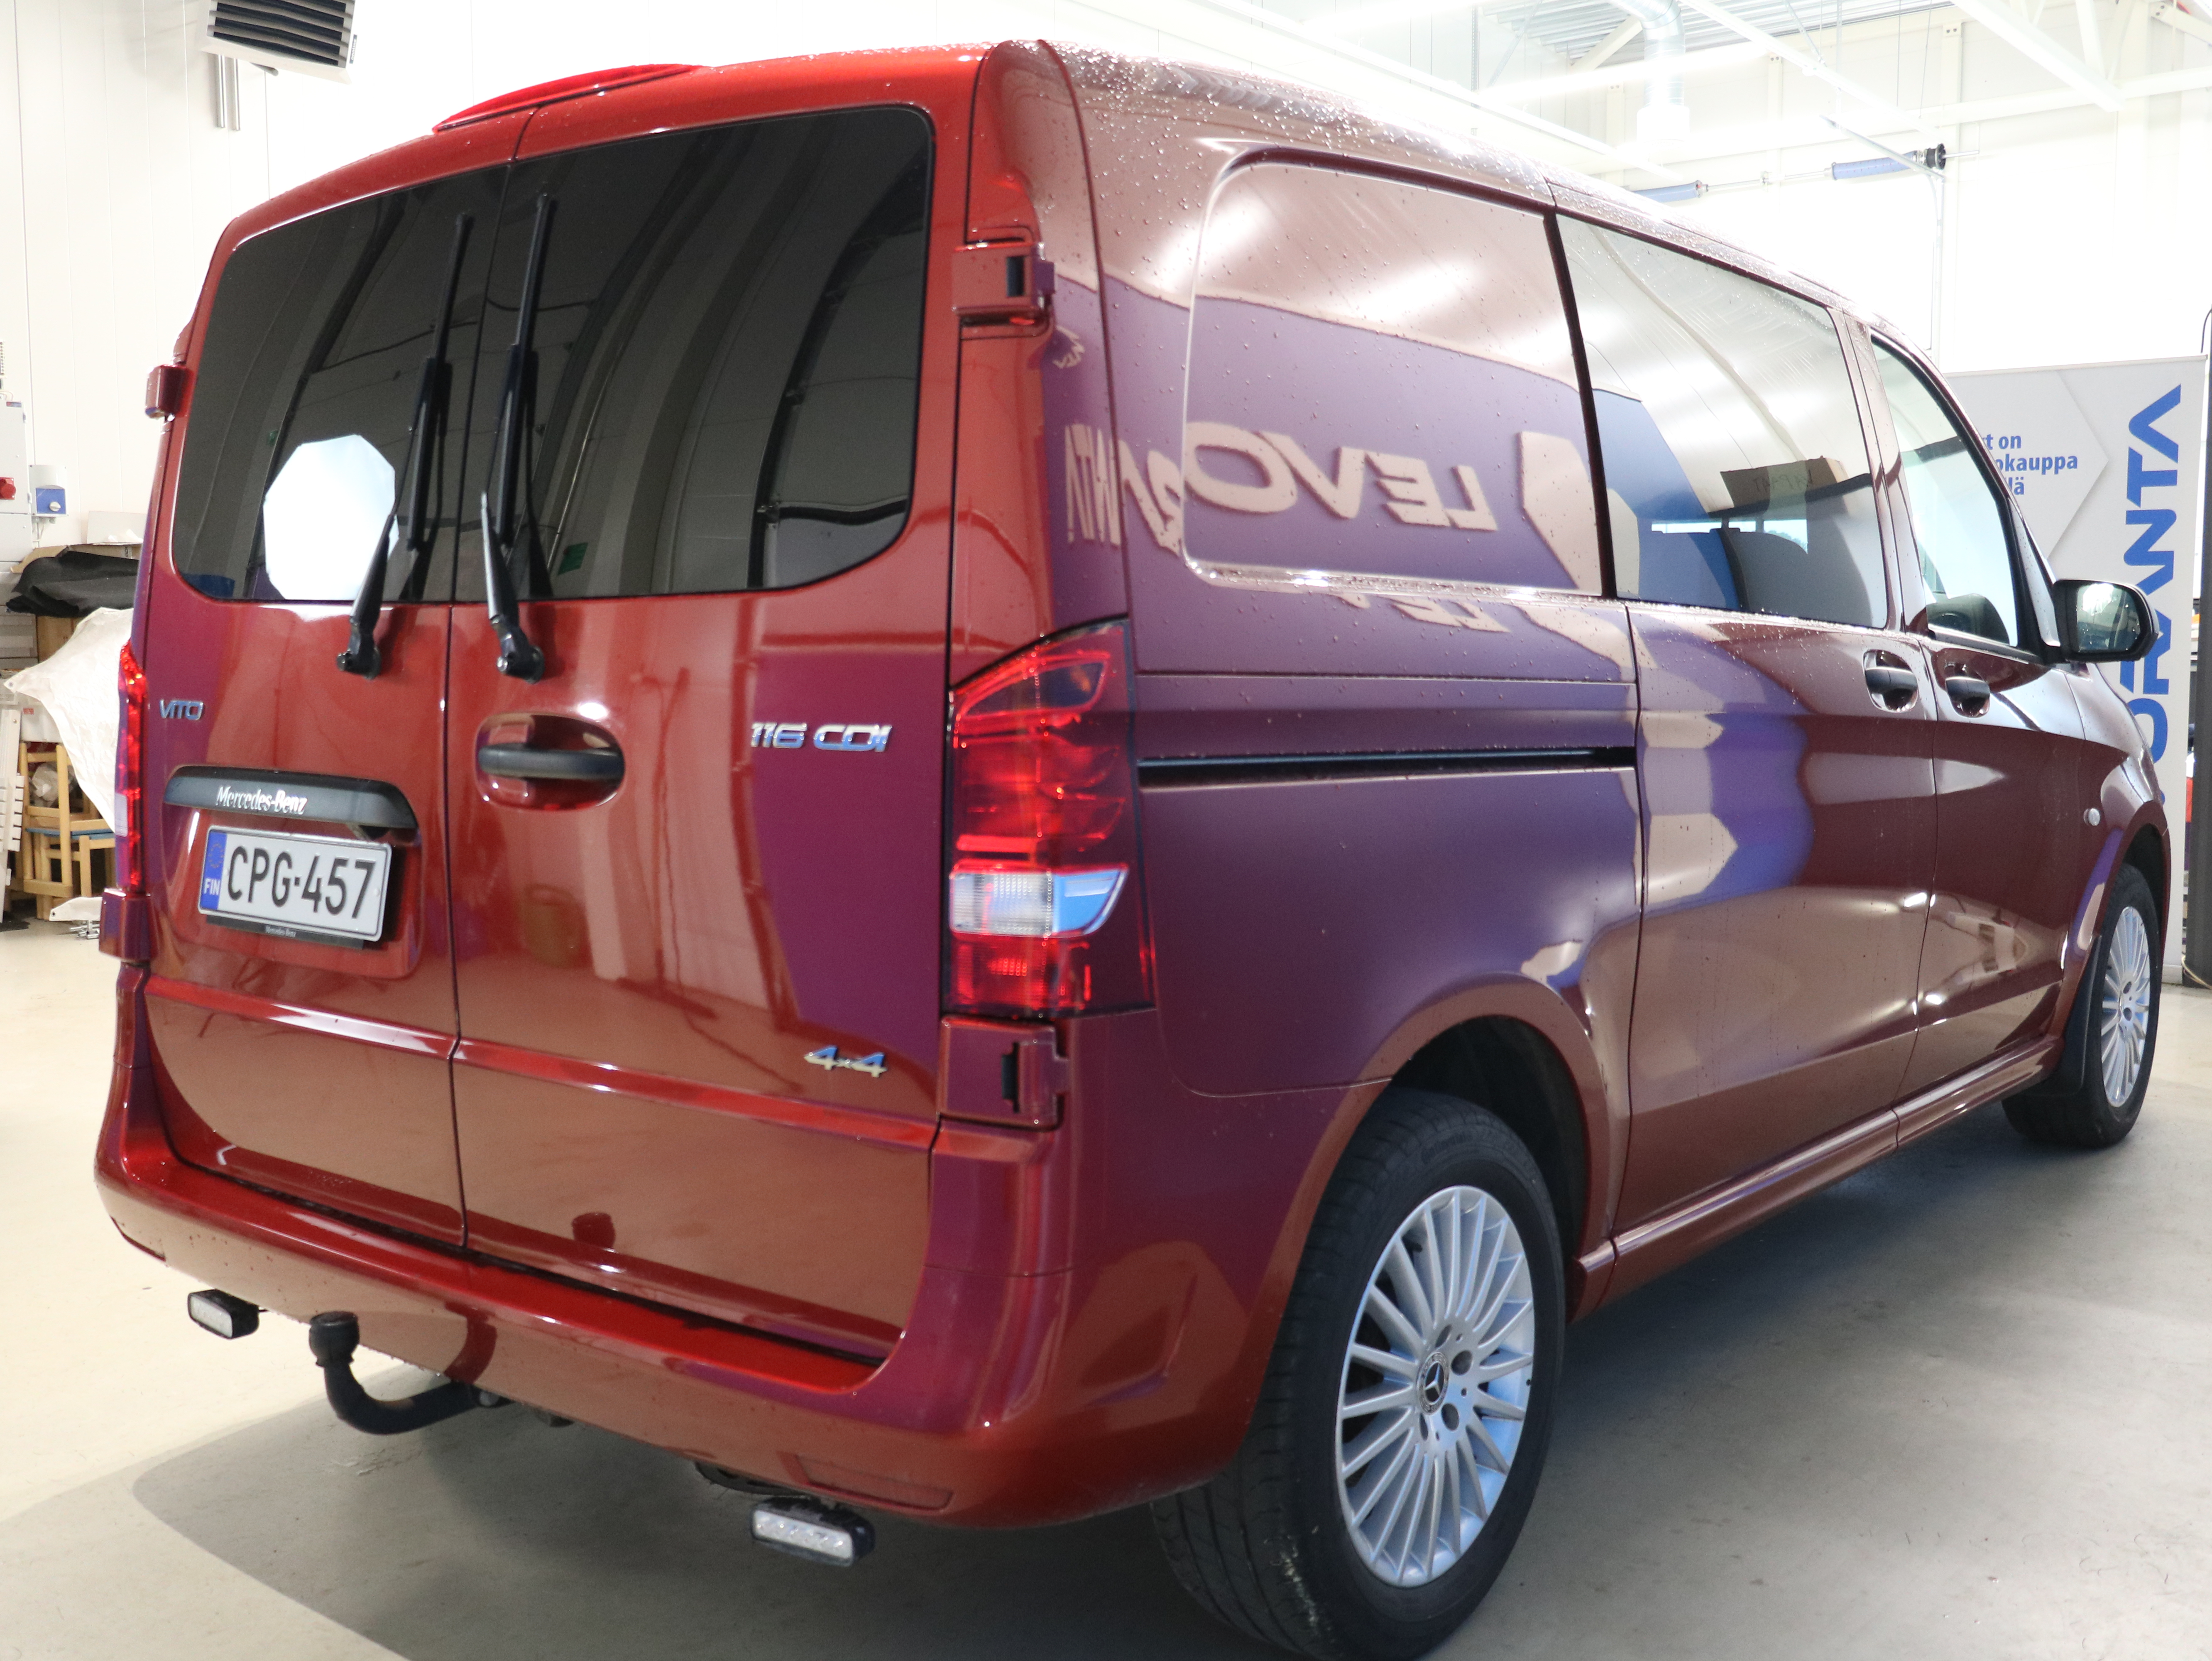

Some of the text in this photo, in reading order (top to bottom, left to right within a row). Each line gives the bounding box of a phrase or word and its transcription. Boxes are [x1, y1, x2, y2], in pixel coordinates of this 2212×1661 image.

[1982, 434, 2021, 450] t on
[1995, 453, 2078, 475] okauppa
[2005, 476, 2025, 495] lä
[2119, 384, 2181, 805] ORANTA
[159, 699, 203, 720] VITO
[750, 722, 893, 752] 116 CDI
[215, 786, 308, 815] Mercedes-Benz
[203, 877, 220, 894] FIN
[228, 846, 376, 919] CPG-457
[804, 1045, 888, 1078] 4x4
